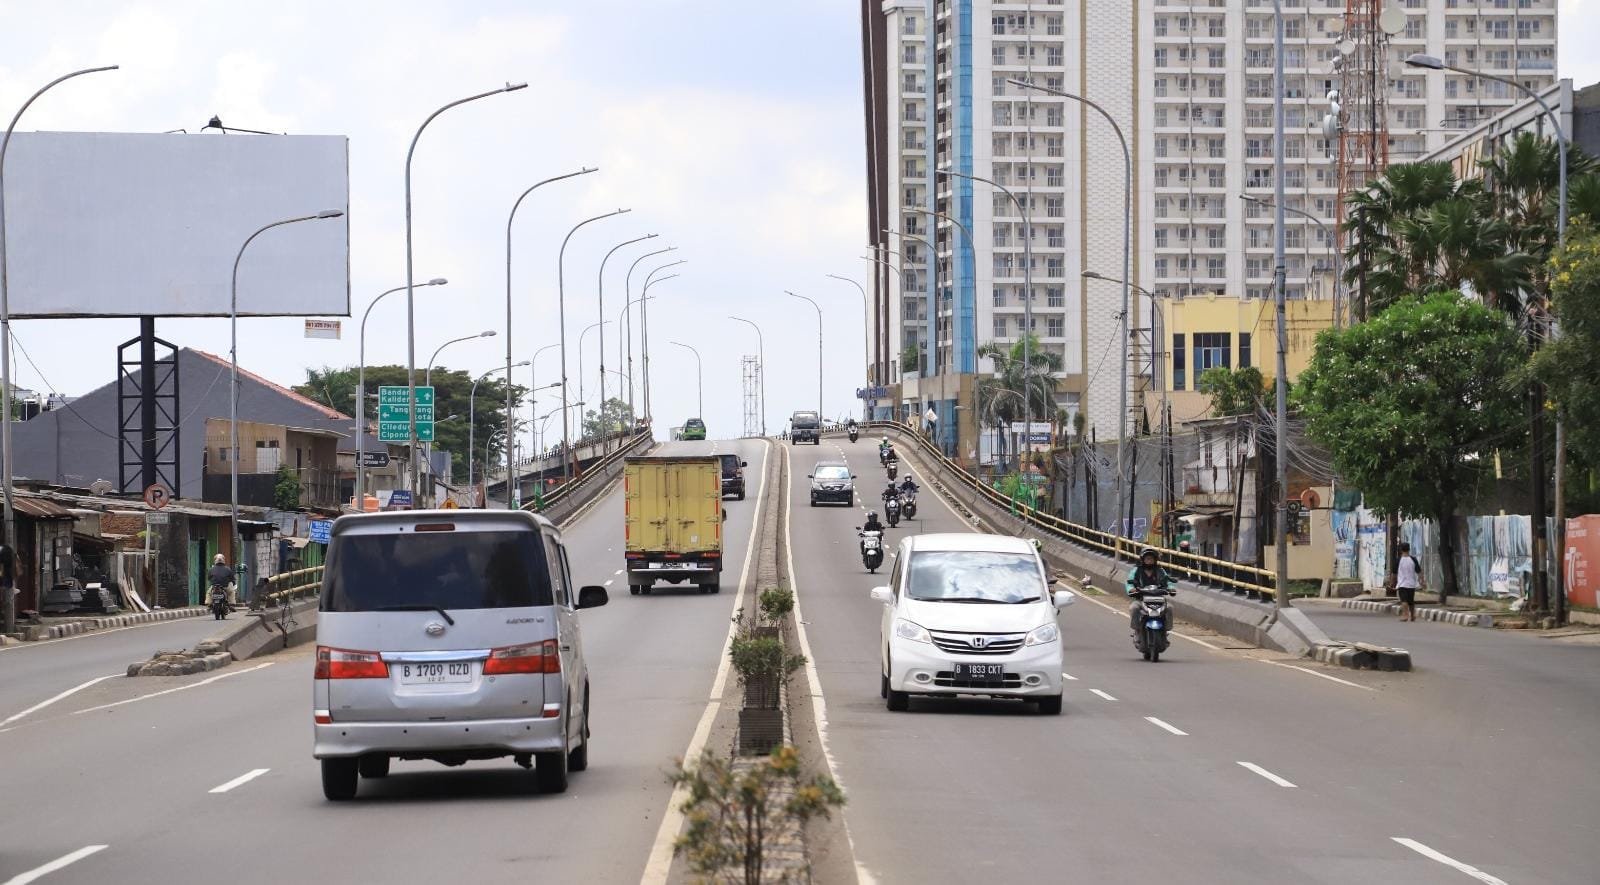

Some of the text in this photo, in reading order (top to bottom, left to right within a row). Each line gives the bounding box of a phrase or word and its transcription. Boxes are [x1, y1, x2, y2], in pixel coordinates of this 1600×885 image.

[389, 405, 431, 414] Tangrang
[152, 489, 163, 503] P
[403, 665, 411, 677] B
[416, 664, 443, 677] 1709
[956, 664, 1002, 674] B 1833 CKT
